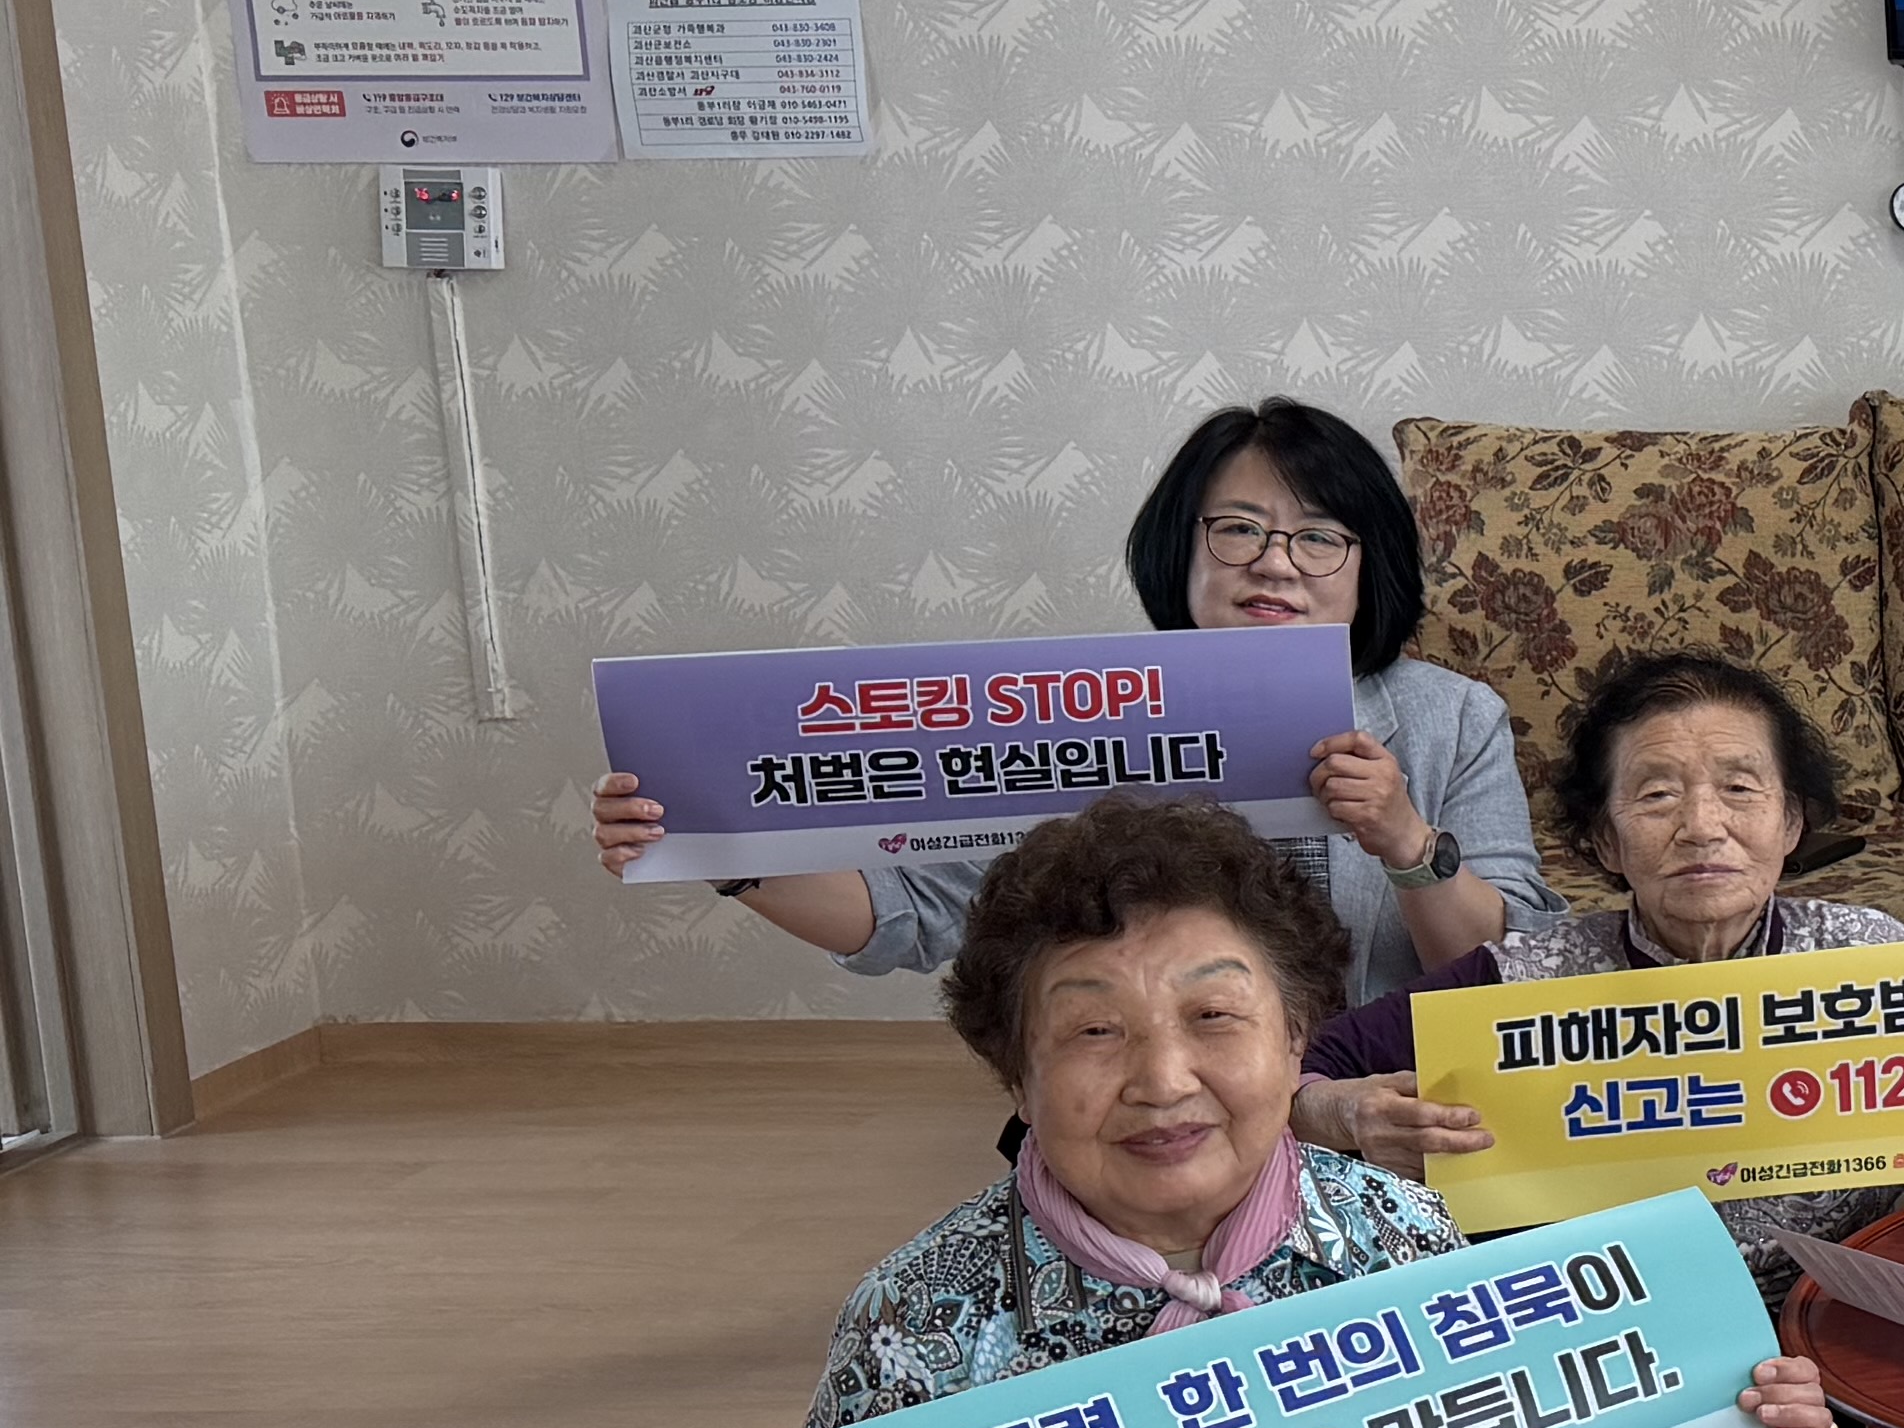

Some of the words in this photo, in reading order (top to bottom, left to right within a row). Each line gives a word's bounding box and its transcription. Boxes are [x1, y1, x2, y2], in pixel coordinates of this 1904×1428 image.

[798, 674, 972, 736] 스토킹
[987, 665, 1166, 726] STOP!
[749, 747, 925, 807] 처벌은
[939, 731, 1225, 798] 현실입니다
[1495, 994, 1742, 1075] 피해자의
[1562, 1074, 1745, 1140] 신고는
[1739, 1153, 1887, 1185] 여성긴급전화1366
[1259, 1311, 1421, 1412] 번의
[1425, 1243, 1649, 1373] 침묵이
